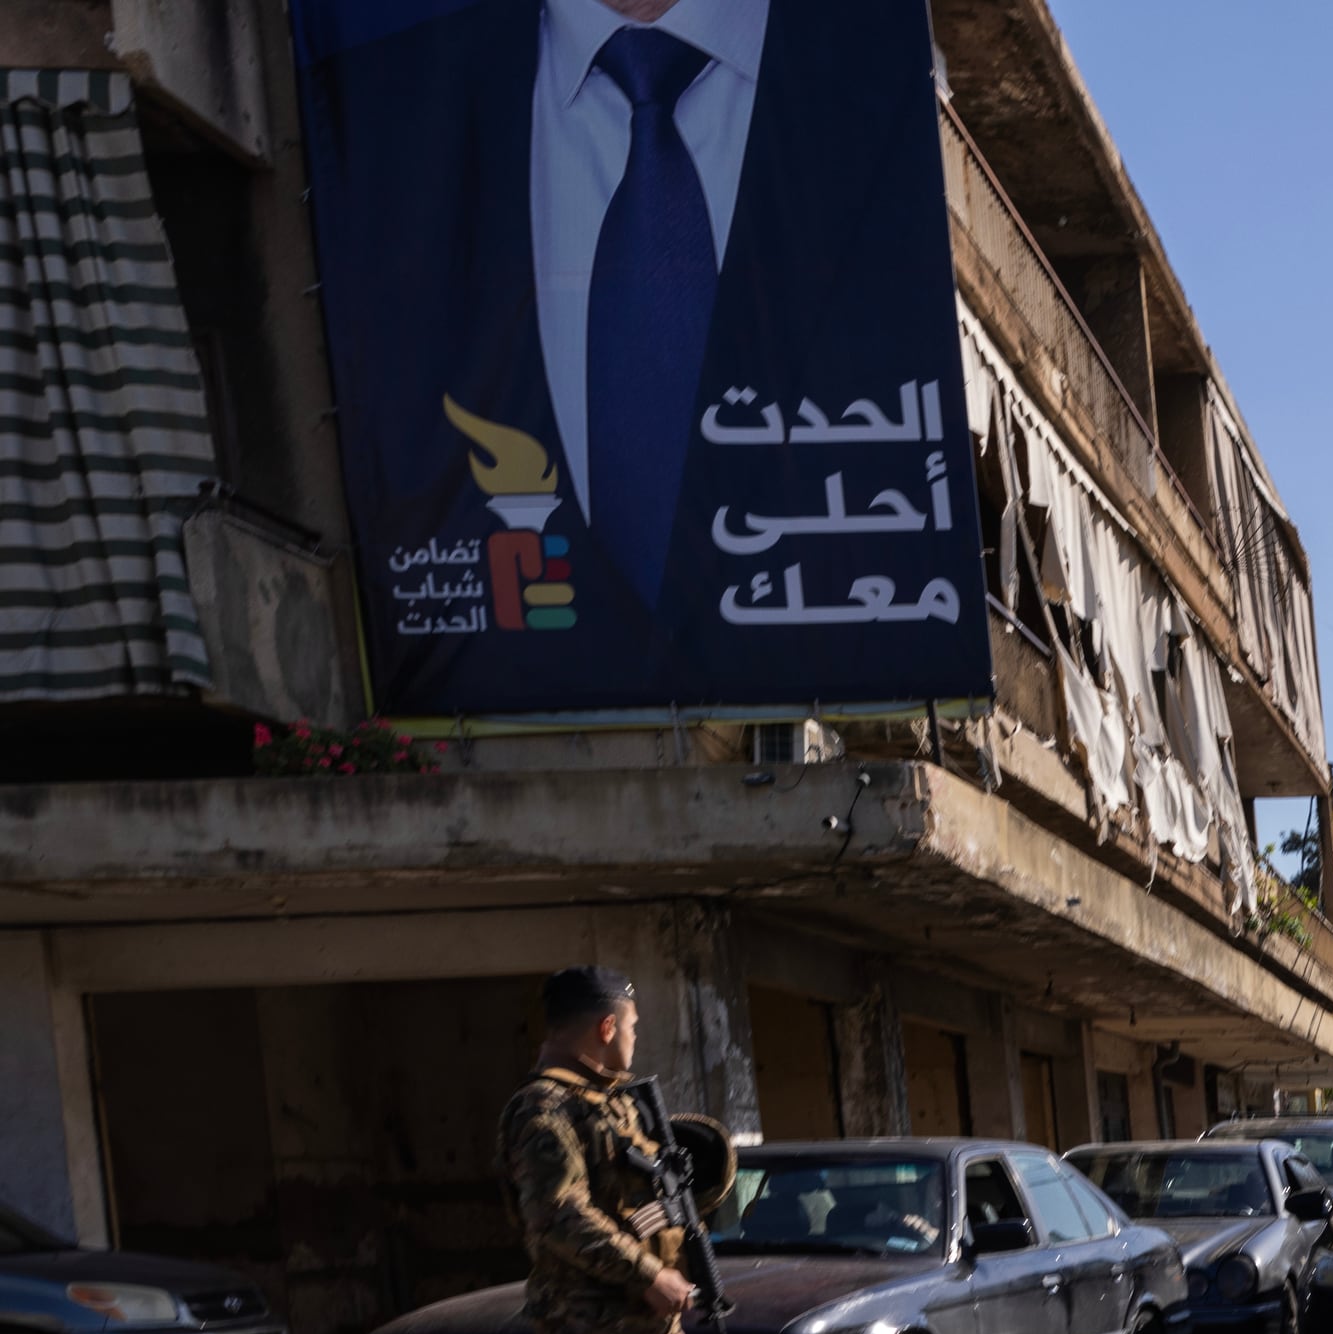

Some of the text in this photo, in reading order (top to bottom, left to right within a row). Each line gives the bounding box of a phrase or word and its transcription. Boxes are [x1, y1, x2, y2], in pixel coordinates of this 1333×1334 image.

[700, 379, 944, 445] الحدت
[711, 451, 953, 555] أحلى
[389, 537, 481, 572] تضامن
[393, 569, 484, 607] شباب
[719, 562, 960, 625] معك
[397, 605, 487, 634] الحدت
